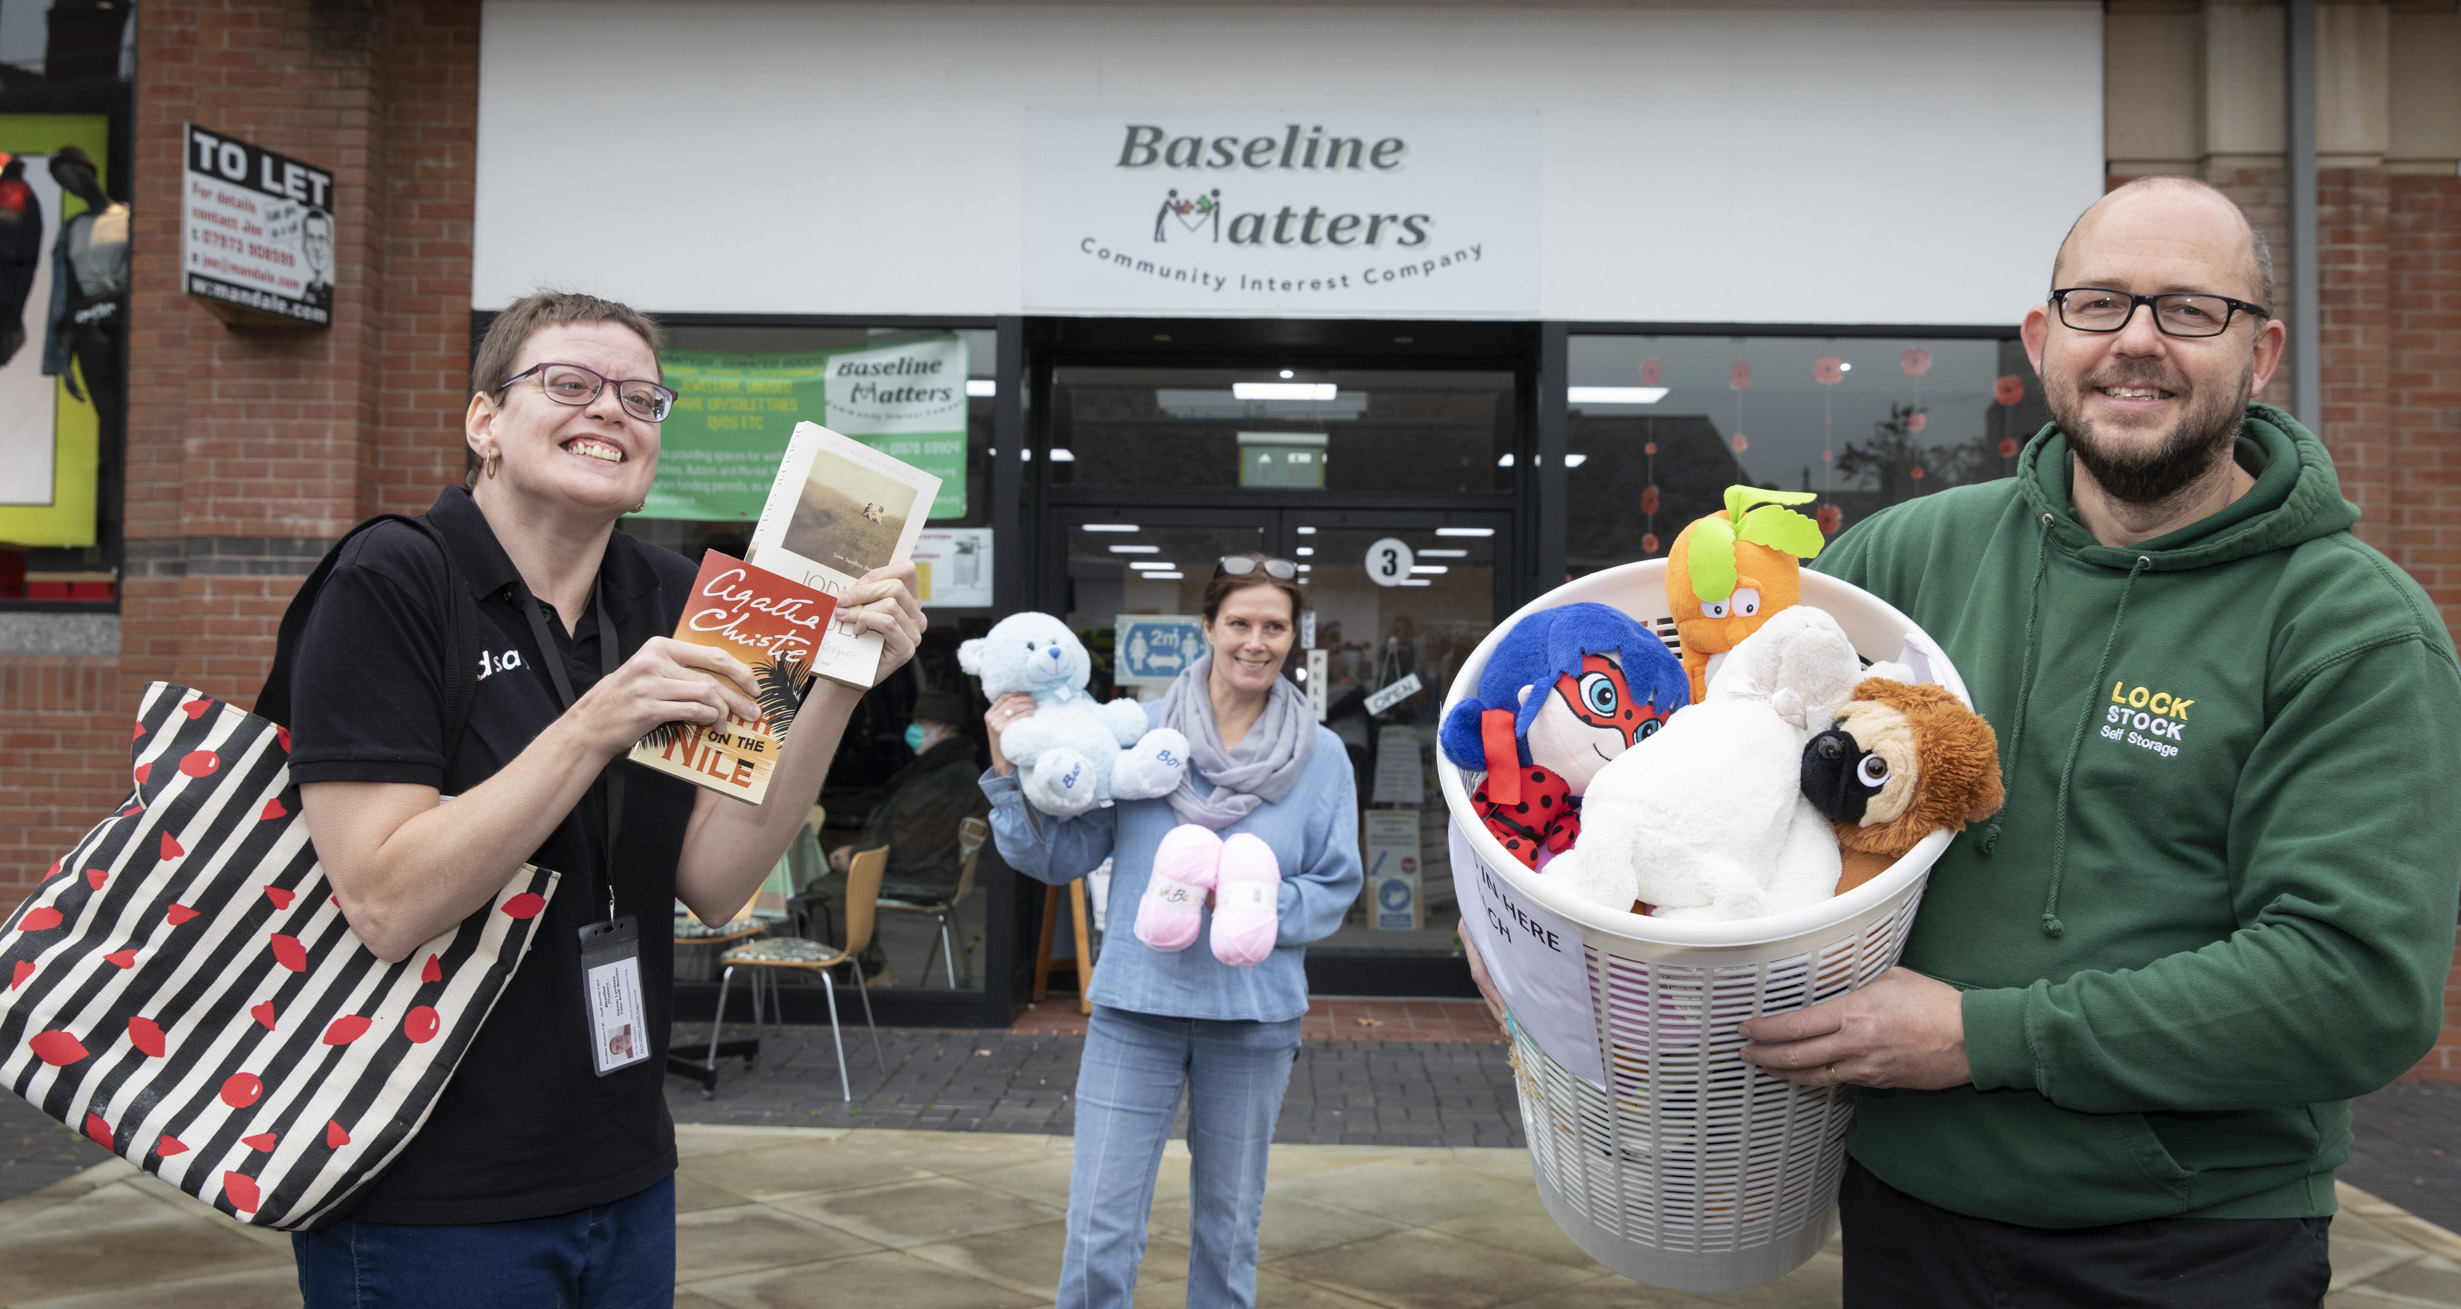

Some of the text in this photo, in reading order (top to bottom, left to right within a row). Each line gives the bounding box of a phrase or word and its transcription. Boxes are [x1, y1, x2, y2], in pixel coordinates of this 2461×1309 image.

[1115, 123, 1406, 171] Baseline
[193, 131, 330, 206] TO LET
[191, 181, 257, 215] For details
[191, 207, 238, 231] contact
[243, 219, 263, 236] Joe
[1154, 186, 1431, 247] Matters
[1080, 237, 1484, 292] Community Interest Company
[837, 357, 943, 377] Baseline
[850, 381, 953, 404] Matters
[1382, 549, 1397, 576] 3
[702, 568, 820, 630] Agatha
[803, 571, 846, 594] JOD
[688, 607, 812, 663] Christie
[477, 650, 530, 681] dsa
[1373, 681, 1415, 710] OPEN
[2112, 681, 2196, 721] LOCK
[2101, 724, 2179, 757] Self Storage
[2106, 705, 2186, 741] STOCK
[661, 725, 756, 789] NILE
[708, 731, 765, 753] ON THE
[1481, 864, 1562, 953] IN HERE
[1487, 907, 1513, 945] CH
